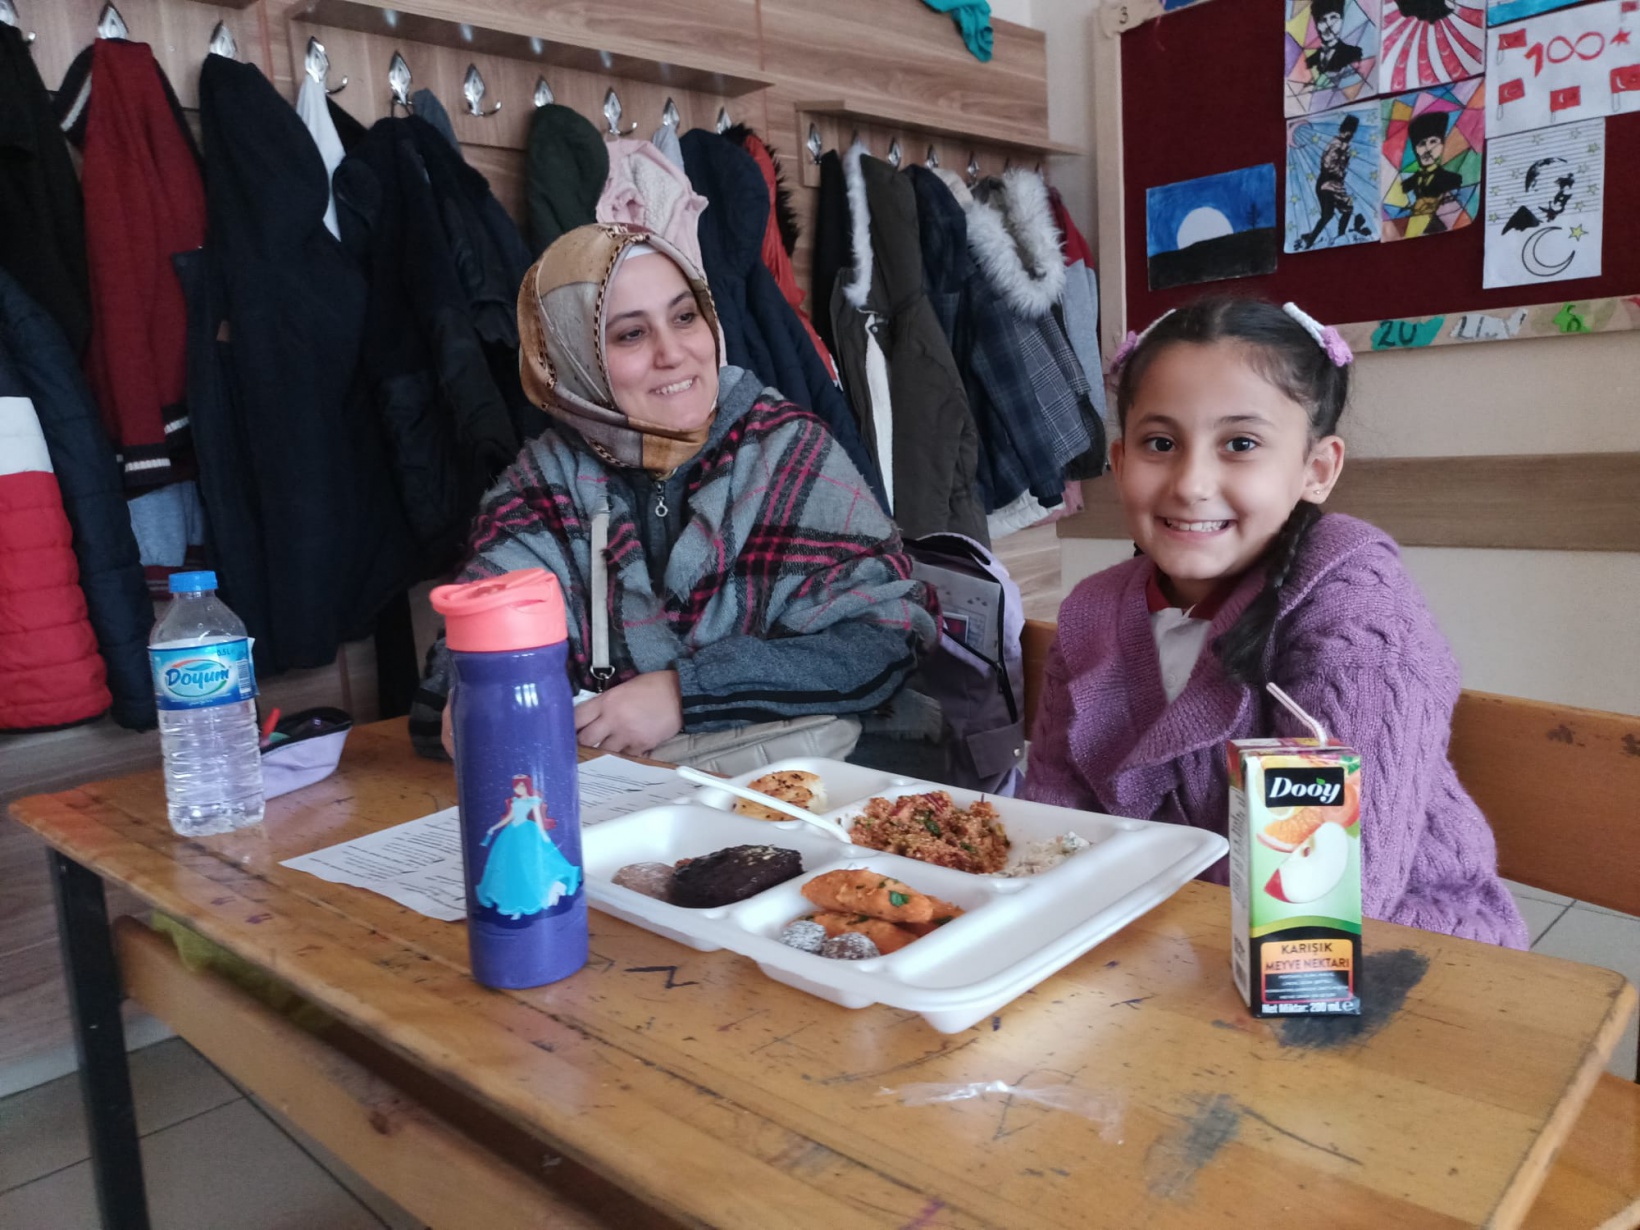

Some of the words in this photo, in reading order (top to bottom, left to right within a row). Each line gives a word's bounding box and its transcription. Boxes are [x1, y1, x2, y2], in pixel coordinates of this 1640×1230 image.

[1524, 31, 1606, 78] 100
[165, 668, 229, 689] Doyum
[1269, 776, 1341, 804] Dooy
[1281, 942, 1333, 955] KARIŞIK
[1265, 960, 1301, 971] MEYVE
[1303, 957, 1350, 969] NEKTARI
